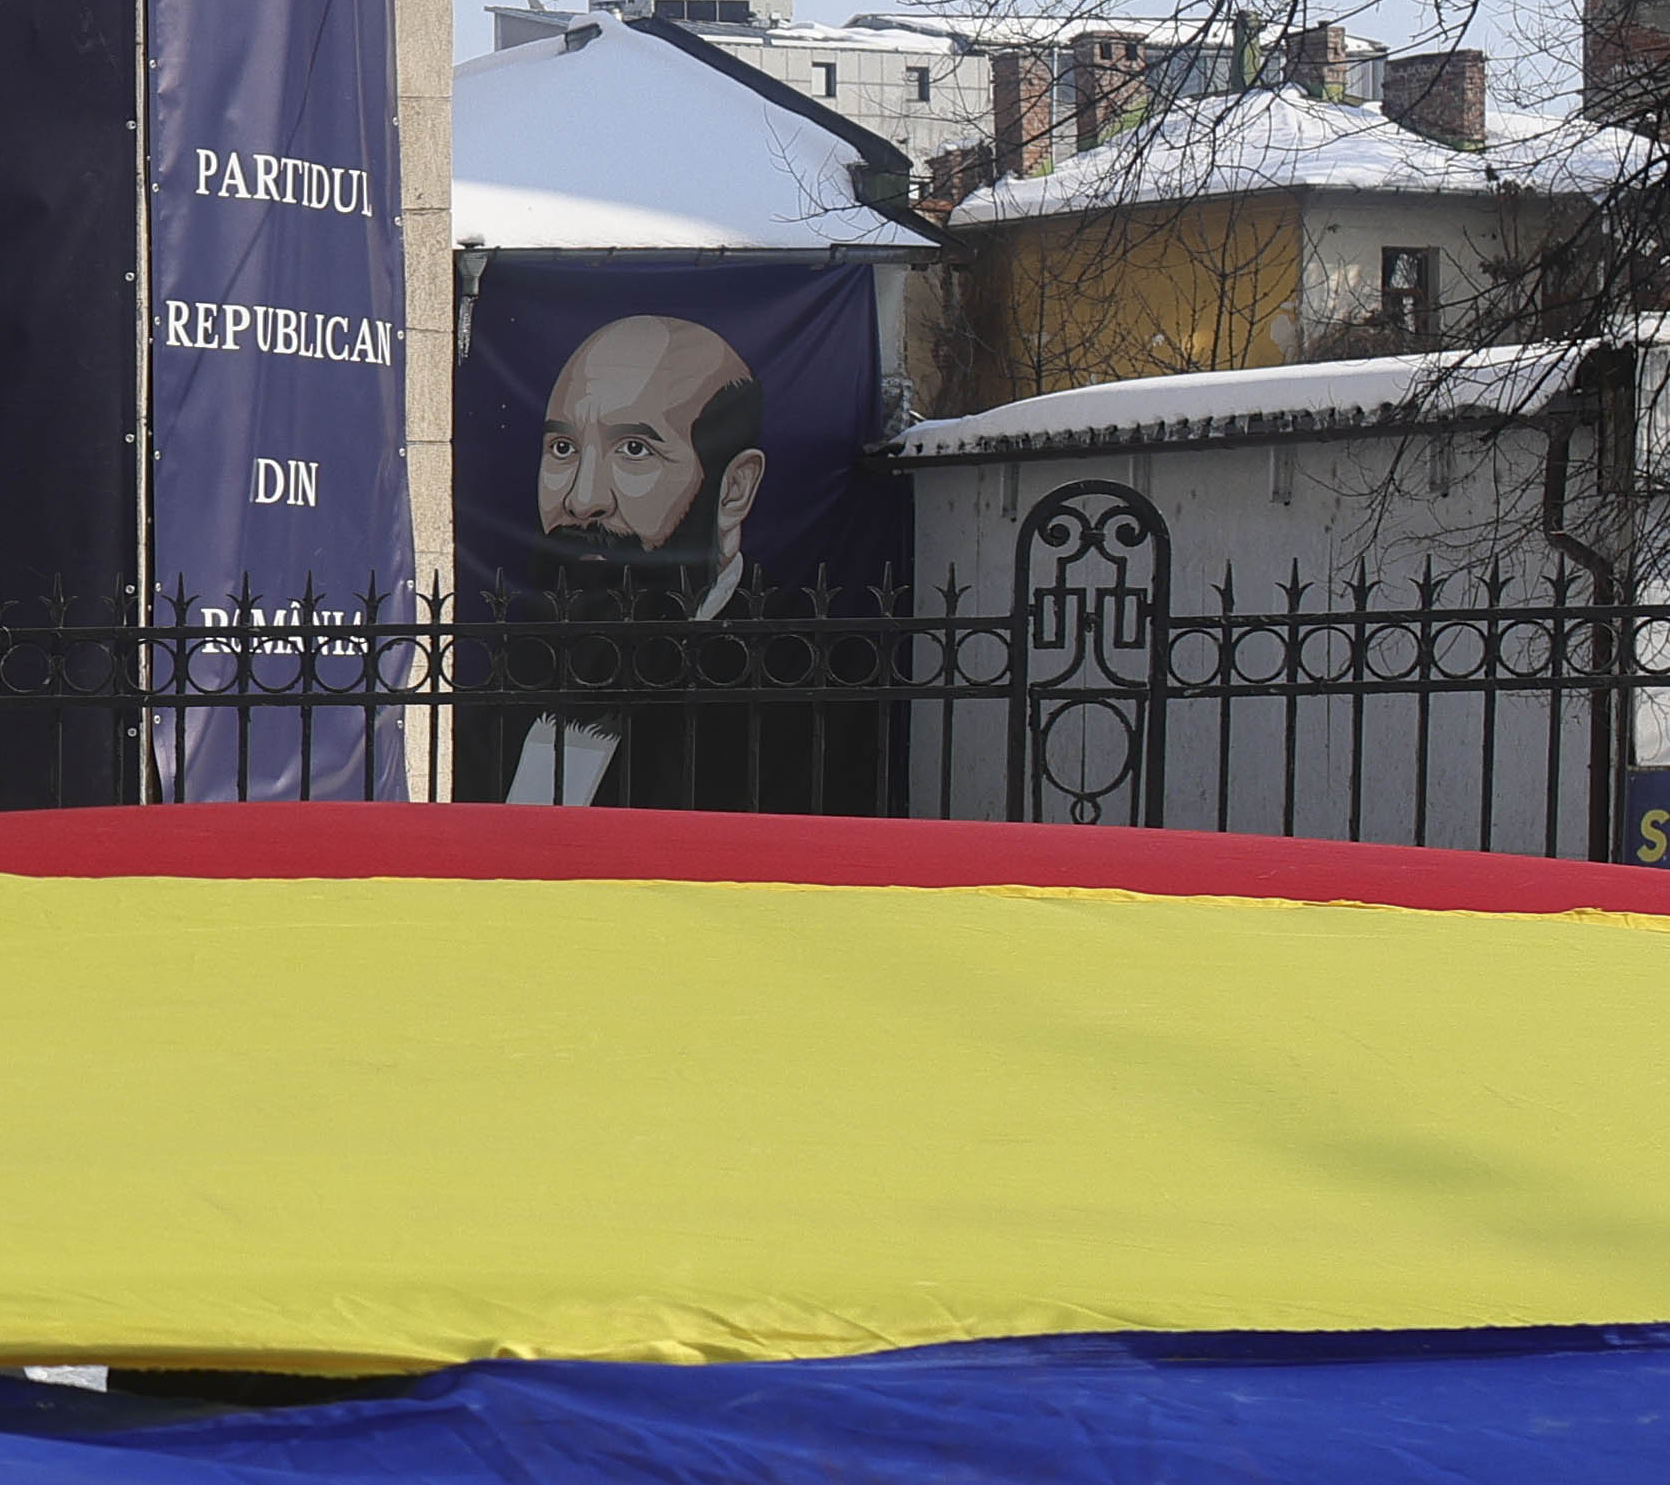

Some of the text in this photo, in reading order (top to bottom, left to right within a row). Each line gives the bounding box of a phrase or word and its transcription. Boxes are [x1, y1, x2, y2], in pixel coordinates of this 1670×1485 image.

[196, 148, 373, 217] PARTIDUL
[166, 300, 392, 366] REPUBLICAN
[251, 457, 320, 507] DIN
